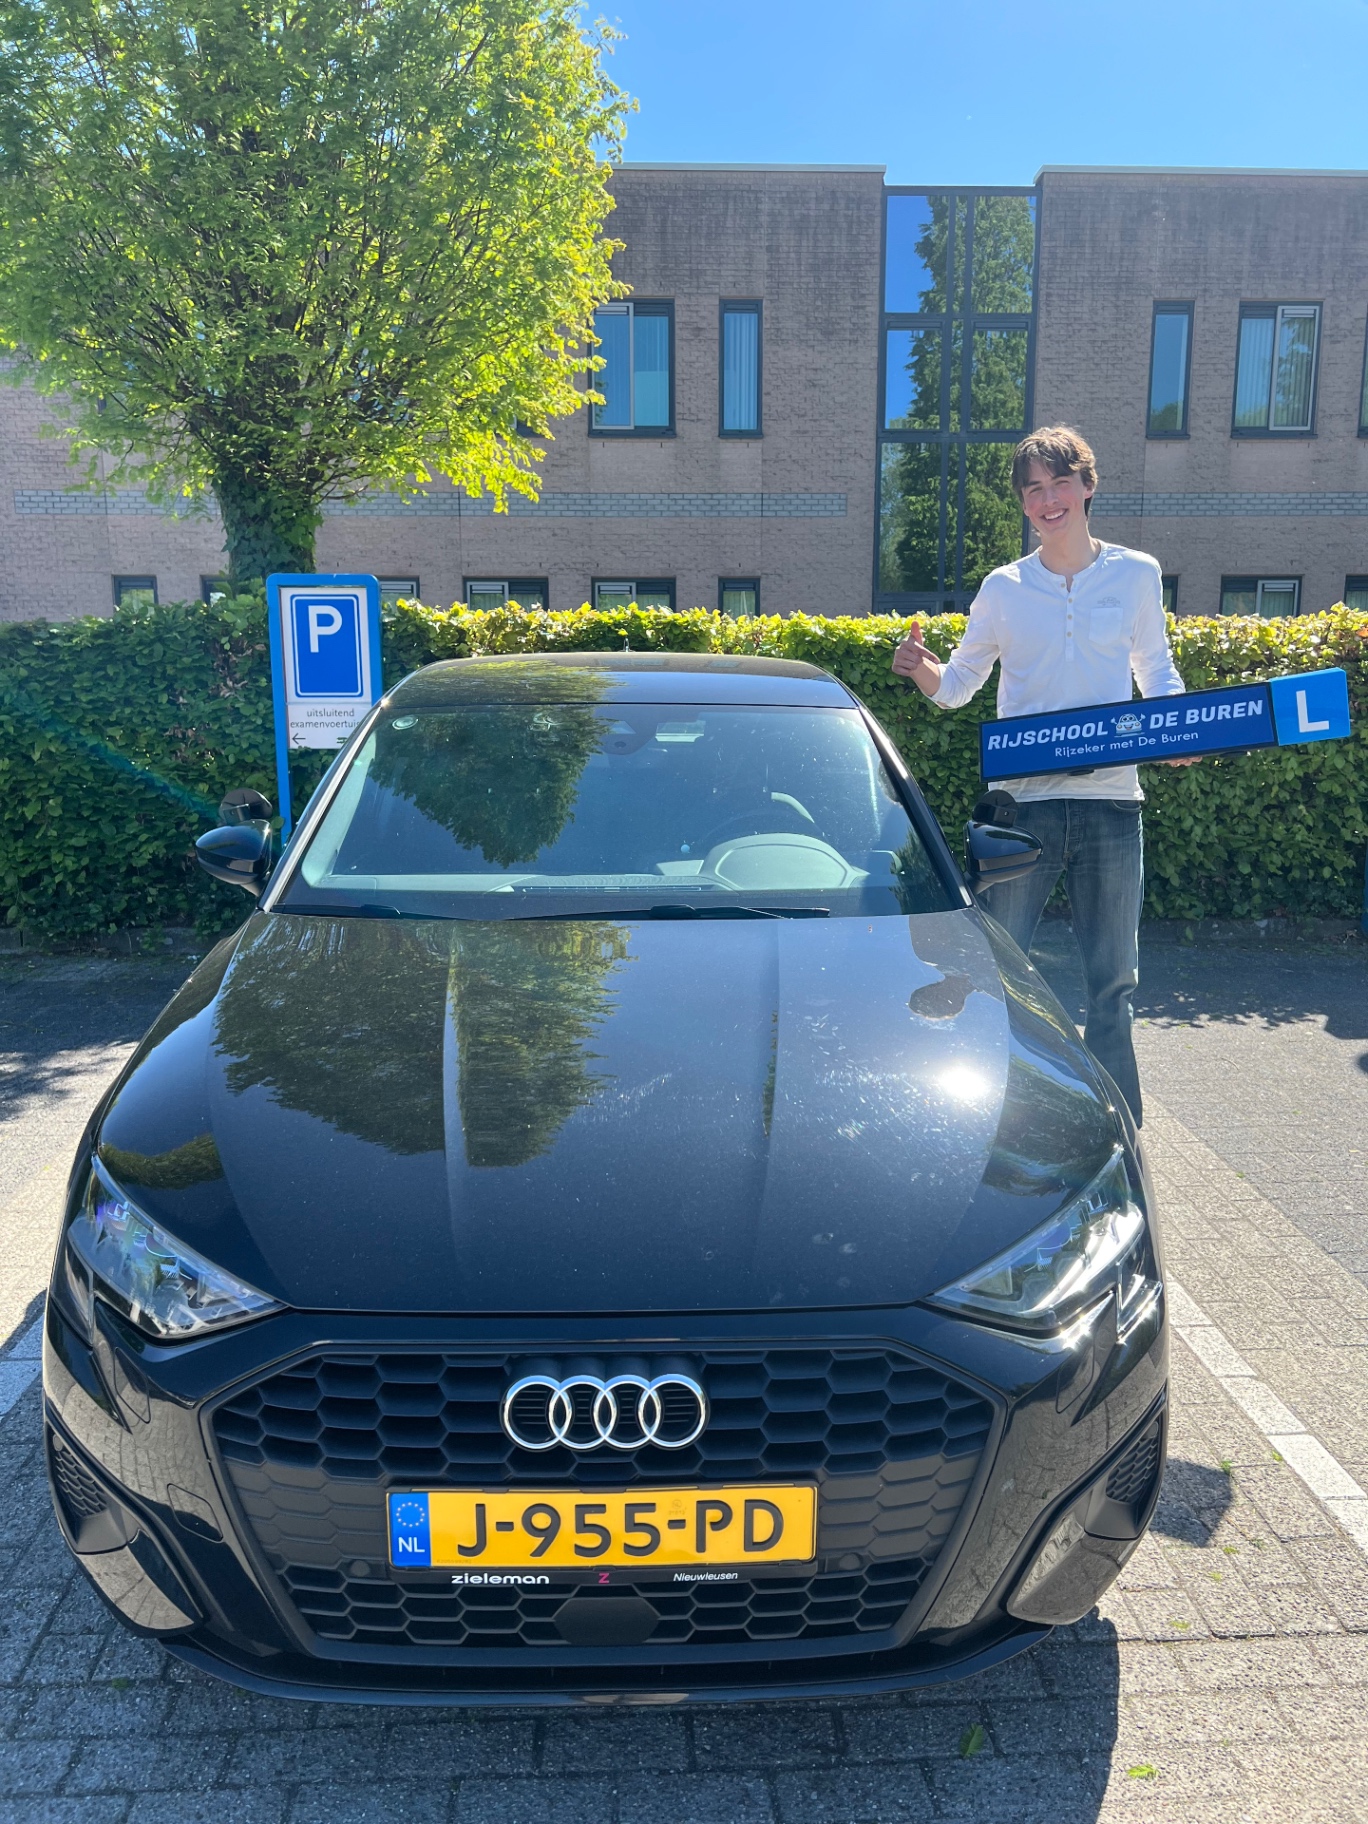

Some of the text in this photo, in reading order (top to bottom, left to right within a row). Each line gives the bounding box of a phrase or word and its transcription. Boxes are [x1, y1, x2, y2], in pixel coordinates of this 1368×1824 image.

[308, 605, 343, 653] P
[307, 708, 355, 717] uitsluitend
[1296, 690, 1330, 733] L
[988, 700, 1263, 750] RIJSCHOOL DE BUREN
[1055, 732, 1199, 757] Rijzeker met De Buren
[457, 1499, 785, 1558] J-955-PD
[398, 1537, 426, 1553] NL
[451, 1572, 550, 1584] zieleman
[673, 1571, 739, 1581] Nieuwleusen
